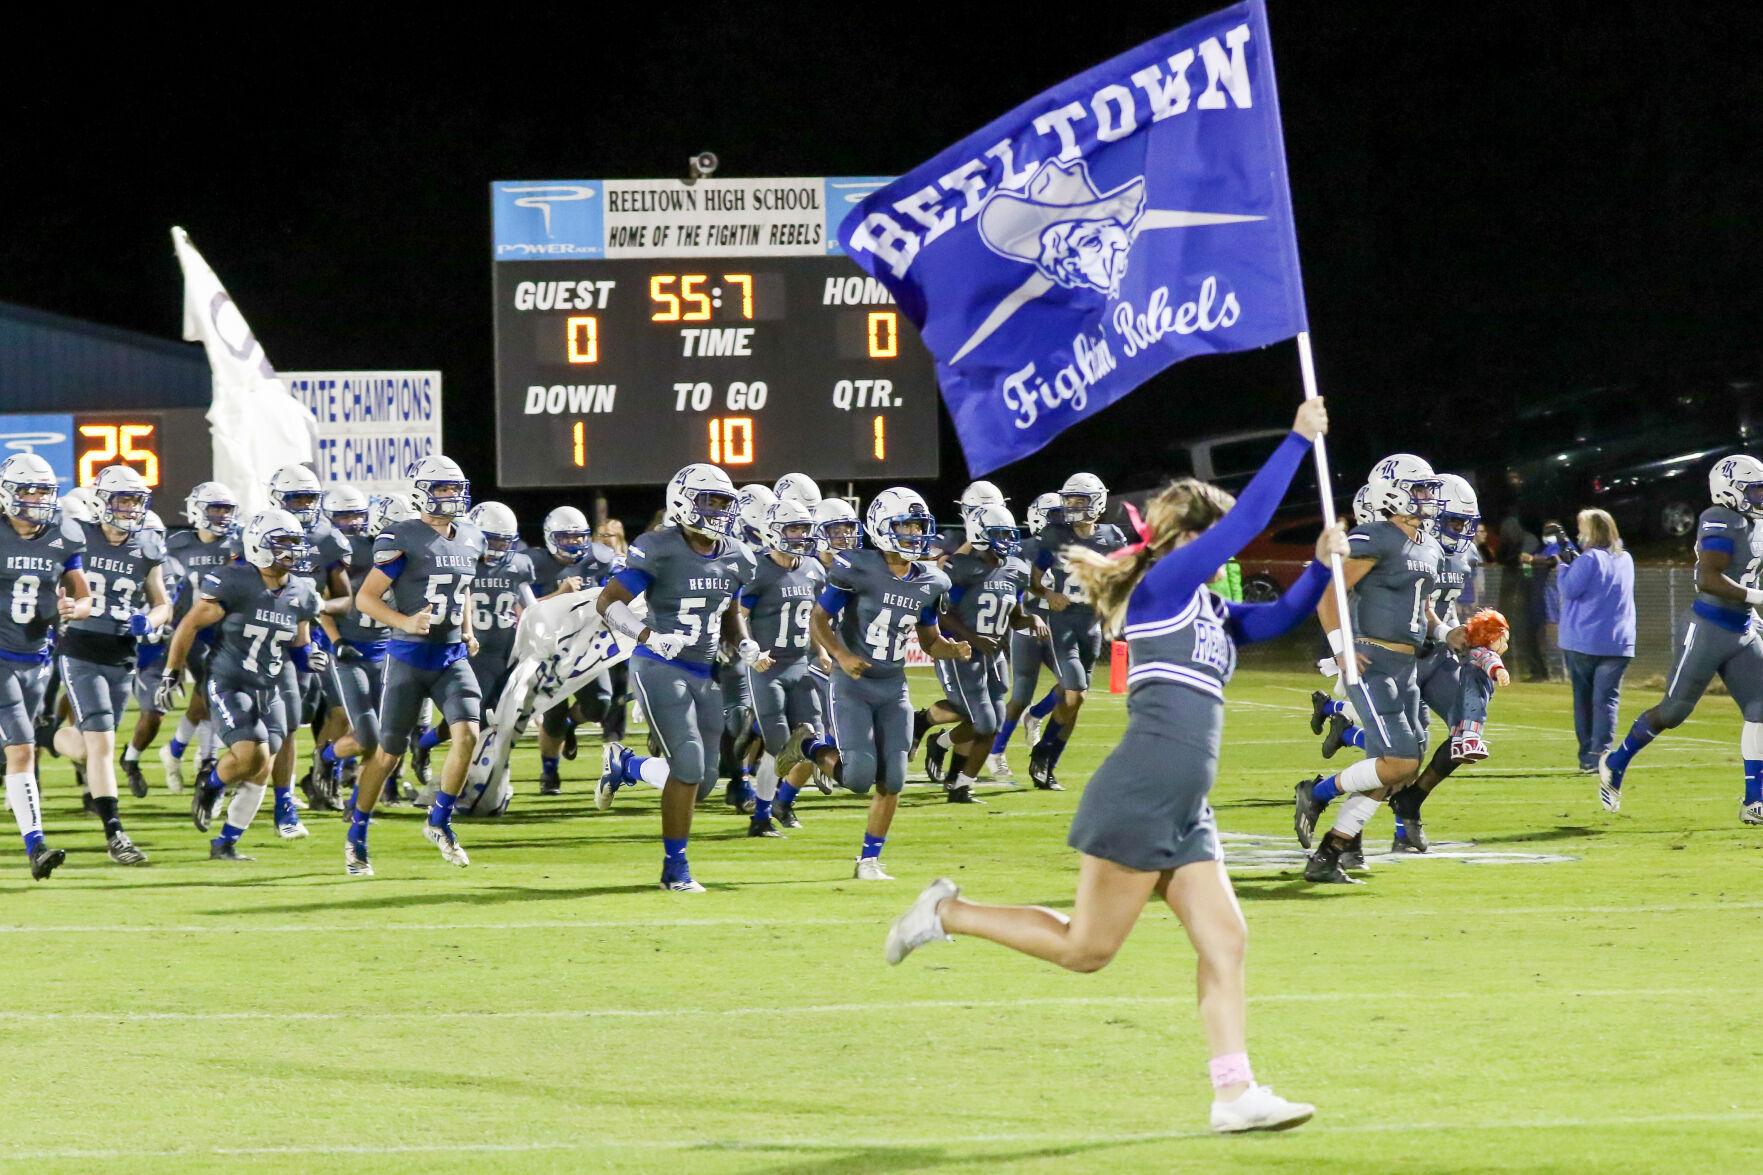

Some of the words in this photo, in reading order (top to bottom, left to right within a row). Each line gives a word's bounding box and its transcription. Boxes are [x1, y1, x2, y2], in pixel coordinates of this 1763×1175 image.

[608, 189, 698, 212] REELTOWN
[704, 189, 746, 211] HIGH
[752, 187, 820, 211] SCHOOL
[608, 225, 648, 248] HOME
[652, 225, 671, 247] OF
[676, 224, 703, 246] THE
[769, 223, 822, 246] REBELS
[514, 280, 616, 311] GUEST
[650, 273, 753, 321] 55:7
[823, 276, 897, 306] HOM
[1113, 275, 1242, 358] Rebels
[566, 316, 599, 364] 0
[680, 327, 756, 357] TIME
[867, 311, 898, 358] 0
[342, 378, 432, 423] CHAMPIONS
[524, 384, 617, 415] DOWN
[673, 382, 714, 411] TO
[726, 381, 768, 411] GO
[832, 379, 903, 411] QTR.
[573, 420, 585, 468] 1
[708, 417, 753, 465] 10
[873, 415, 886, 461] 1
[79, 424, 159, 488] 25
[6, 556, 53, 572] REBELS
[90, 556, 134, 575] REBELS
[435, 555, 473, 568] REBELS
[474, 577, 511, 588] REBELS
[688, 577, 731, 591] REBELS
[781, 585, 812, 598] REBELS
[10, 574, 41, 624] 8
[883, 592, 922, 611] REBELS
[976, 592, 1018, 636] 20
[1409, 577, 1426, 633] 1
[255, 608, 293, 626] REBELS
[774, 600, 814, 649] 19
[242, 623, 294, 678] 75
